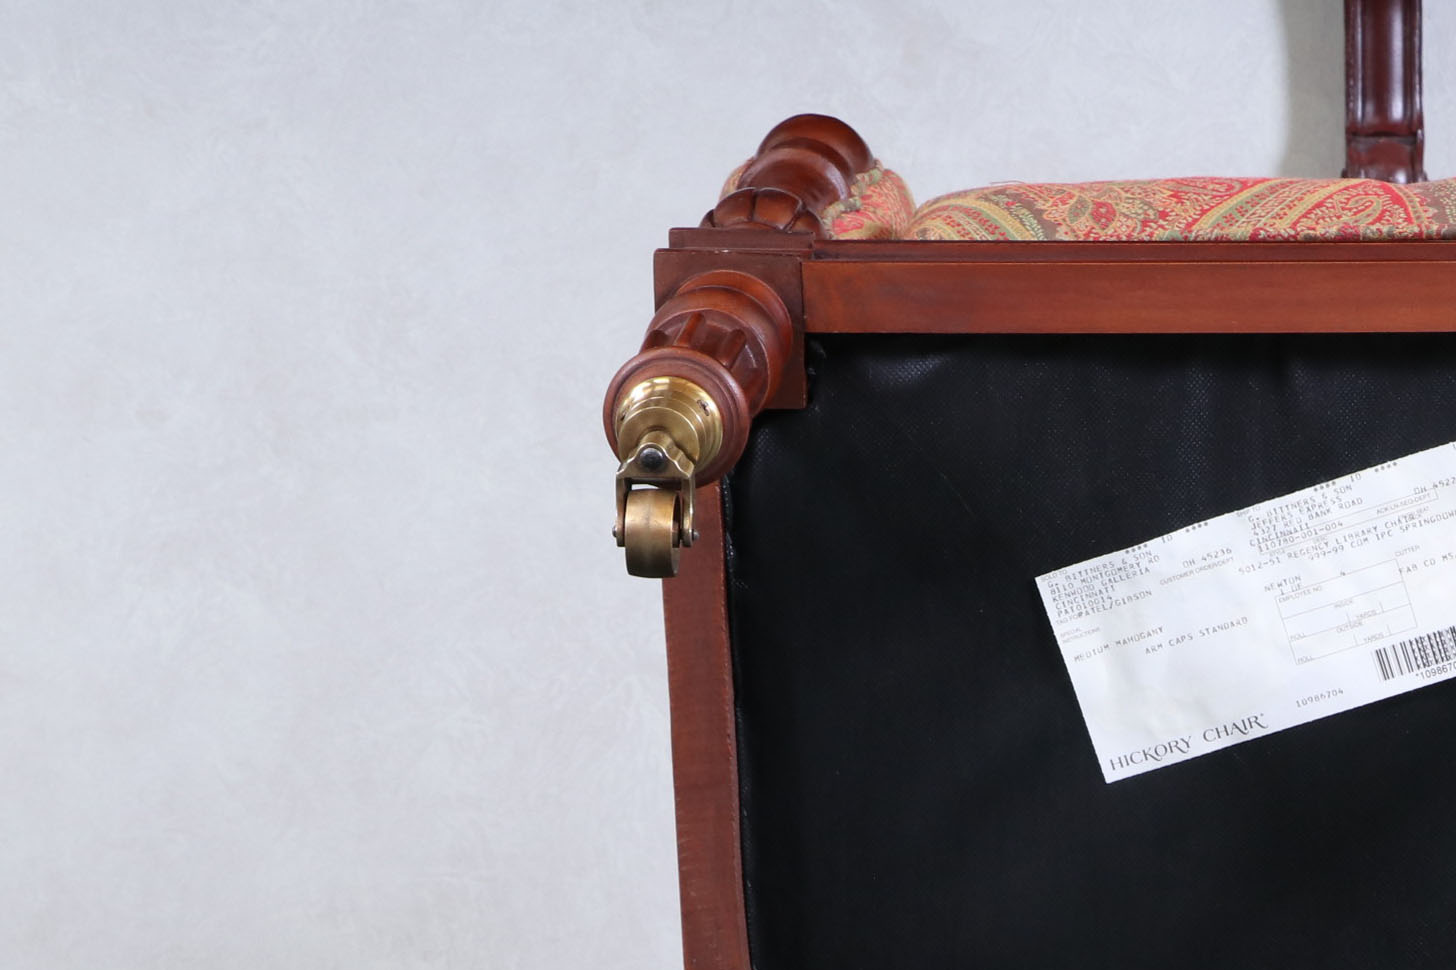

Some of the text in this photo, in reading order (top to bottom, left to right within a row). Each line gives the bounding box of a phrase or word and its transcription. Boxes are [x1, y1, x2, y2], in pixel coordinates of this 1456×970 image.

[1334, 485, 1353, 495] SON
[1249, 523, 1310, 546] CINCINNATI
[1133, 550, 1152, 561] SON
[1287, 542, 1330, 559] REGENCY
[1052, 567, 1150, 602] KENWOOD GALLERIA
[1081, 561, 1141, 585] MONTGOMERY
[1264, 575, 1302, 592] NEWTON
[1055, 585, 1115, 609] CINCINNATI
[1115, 627, 1164, 647] MAHOGANY
[1145, 616, 1249, 654] ARM CAPS STANDARD
[1110, 714, 1267, 770] HICKORY CHAIR
